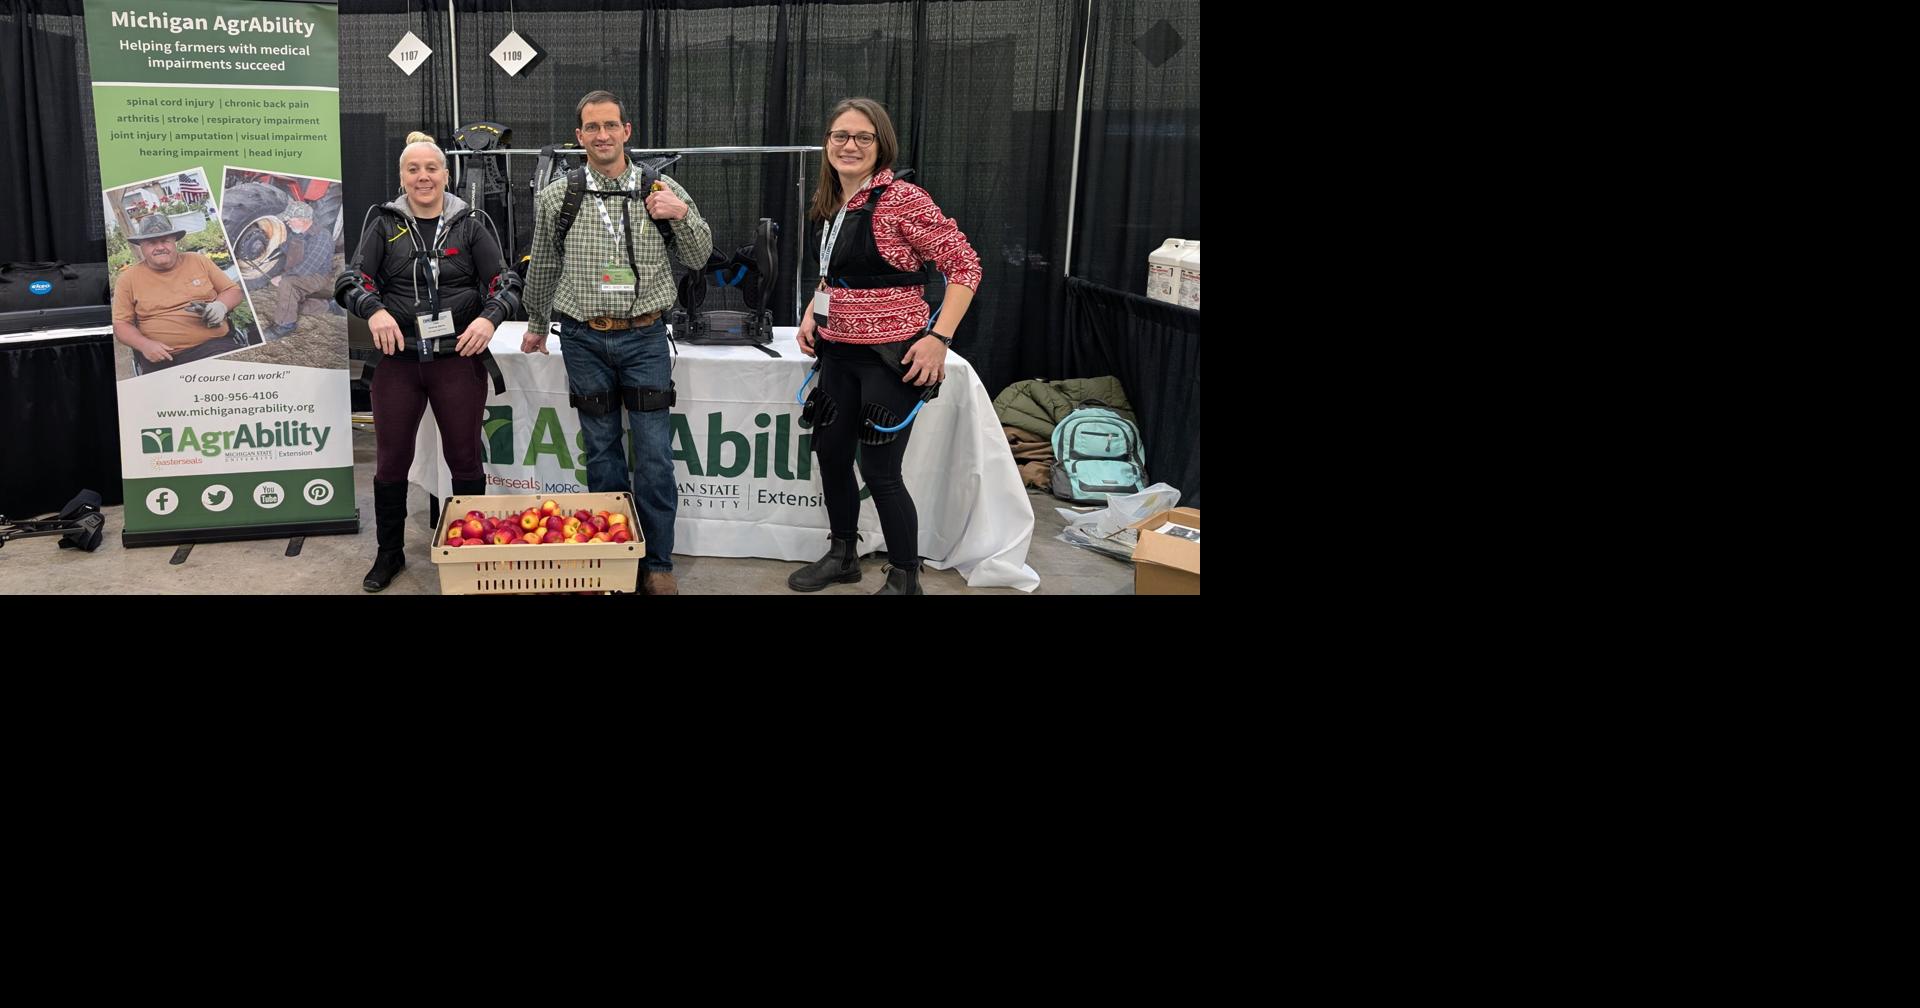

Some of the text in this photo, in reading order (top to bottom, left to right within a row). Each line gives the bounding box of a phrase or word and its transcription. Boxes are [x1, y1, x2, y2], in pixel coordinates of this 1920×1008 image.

[111, 11, 315, 38] Michigan AgrAbility
[119, 39, 310, 56] Helping farmers with medical
[400, 50, 419, 61] 1107
[502, 51, 522, 61] 1109
[148, 57, 285, 71] impairments succeed
[126, 98, 309, 111] spinal cord injury chronic back pain
[117, 114, 320, 127] arthritis stroke respiratory impairment
[110, 131, 328, 144] joint injury amputation visual impairment
[139, 148, 303, 160] hearing impairment head injury
[198, 374, 230, 383] course
[232, 373, 237, 381] I
[193, 391, 279, 403] 1-800-956-4106
[157, 404, 315, 418] www.michiganagrability.org
[177, 420, 331, 458] AgrAbility
[278, 449, 313, 458] Extension
[156, 457, 203, 466] easterseals
[262, 485, 275, 494] You
[485, 473, 580, 494] terseals MORC
[700, 484, 740, 495] STATE
[757, 489, 823, 507] Extensi
